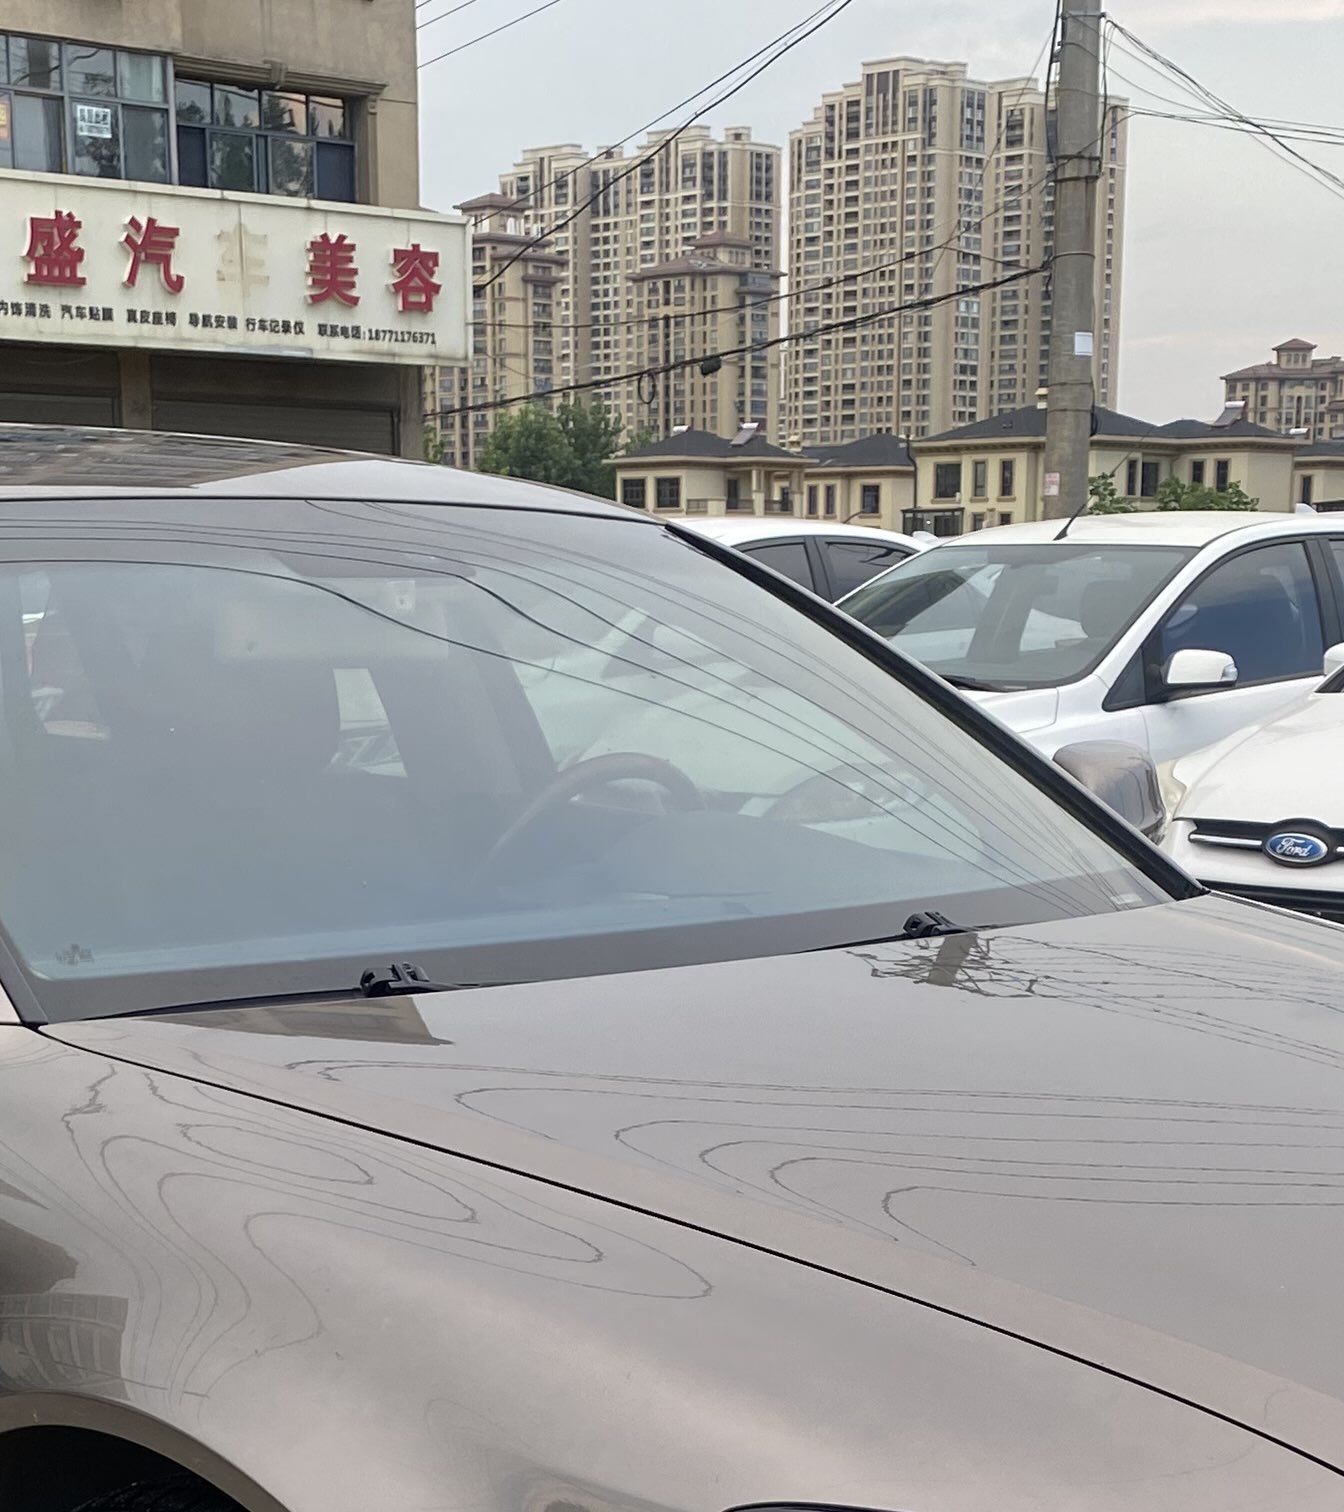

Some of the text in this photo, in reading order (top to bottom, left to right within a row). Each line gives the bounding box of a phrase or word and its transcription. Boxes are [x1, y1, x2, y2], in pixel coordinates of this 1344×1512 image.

[61, 304, 115, 322] 汽车贴膜
[126, 308, 177, 327] 真皮座椅
[246, 317, 305, 336] 行车记录仪
[1275, 837, 1314, 858] Ford
